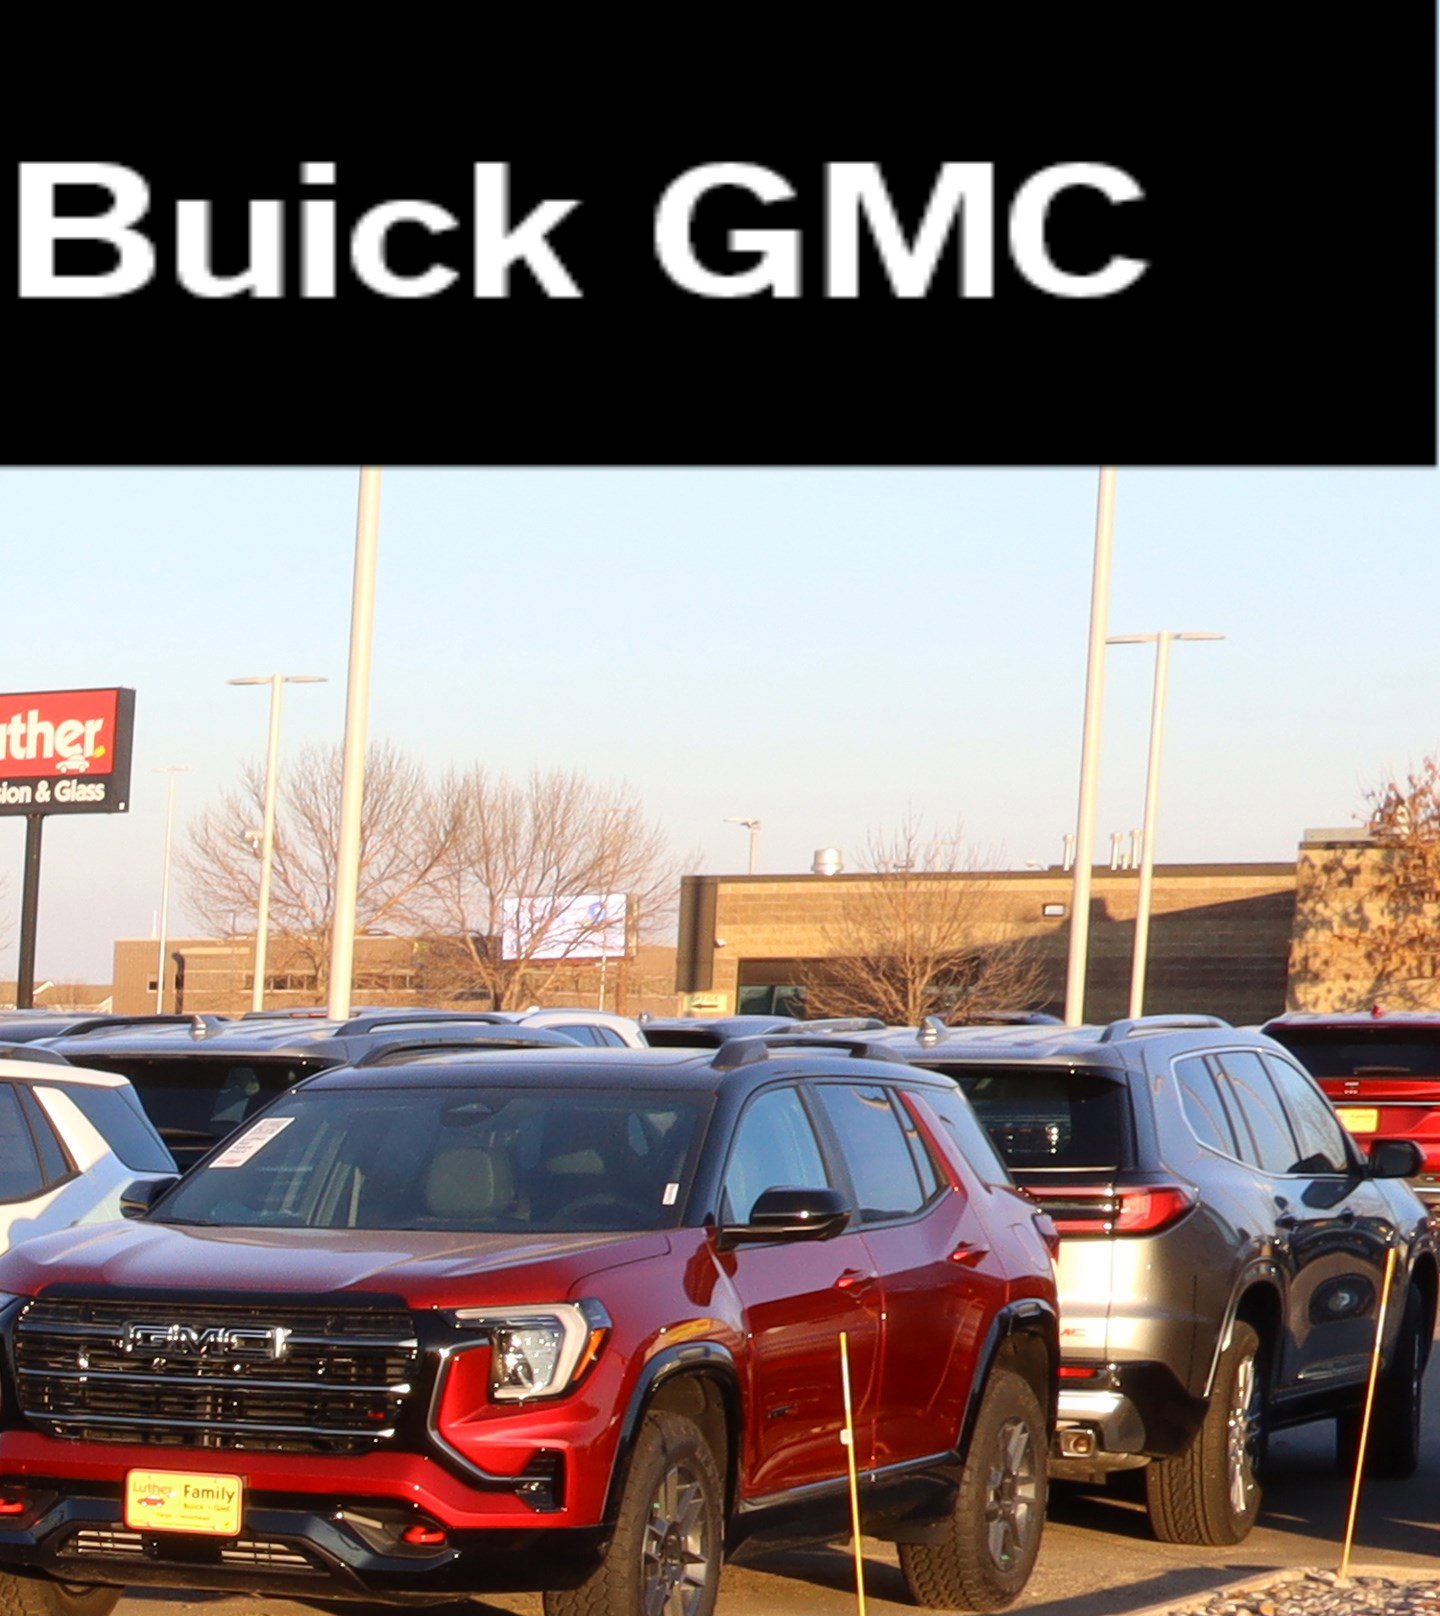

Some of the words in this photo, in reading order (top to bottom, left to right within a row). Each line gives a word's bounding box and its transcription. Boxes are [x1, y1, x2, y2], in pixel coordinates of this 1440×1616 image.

[35, 780, 51, 803] &
[54, 779, 106, 802] Glass
[128, 1323, 278, 1360] GMC
[183, 1484, 235, 1504] Family
